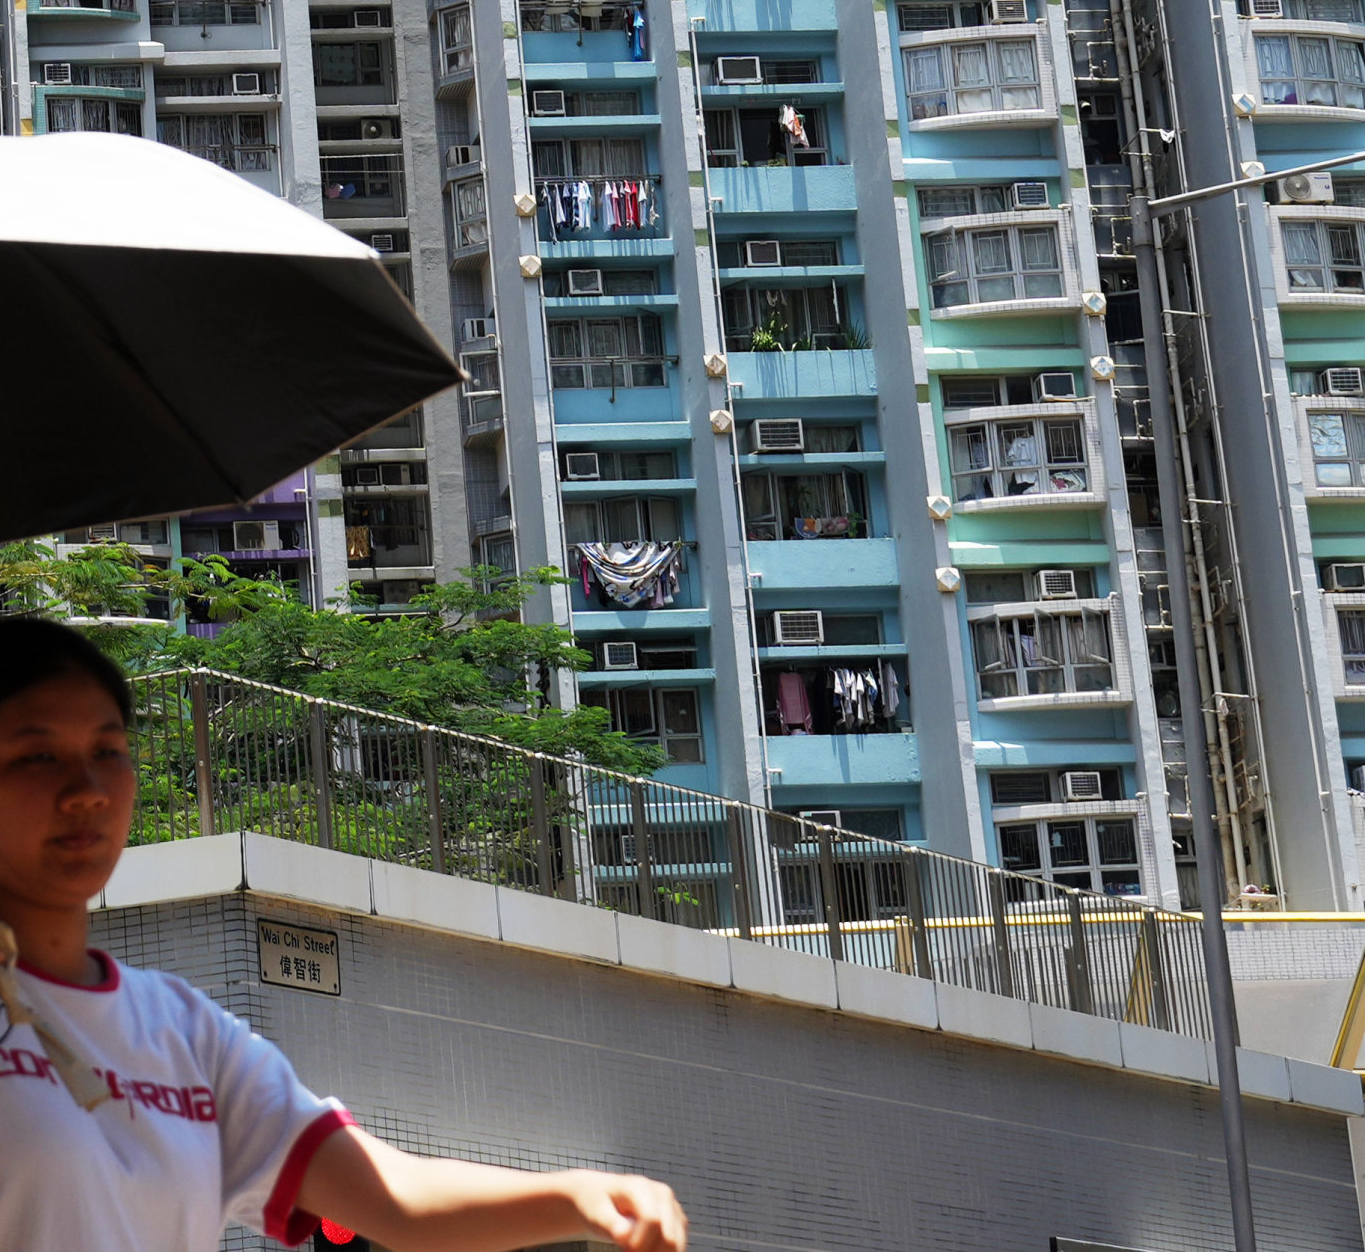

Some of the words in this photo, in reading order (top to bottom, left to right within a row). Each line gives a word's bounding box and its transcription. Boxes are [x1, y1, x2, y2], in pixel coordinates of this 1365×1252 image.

[262, 928, 280, 945] Wai
[284, 931, 300, 948] Chi
[304, 936, 334, 956] Street
[280, 955, 321, 983] 偉智街
